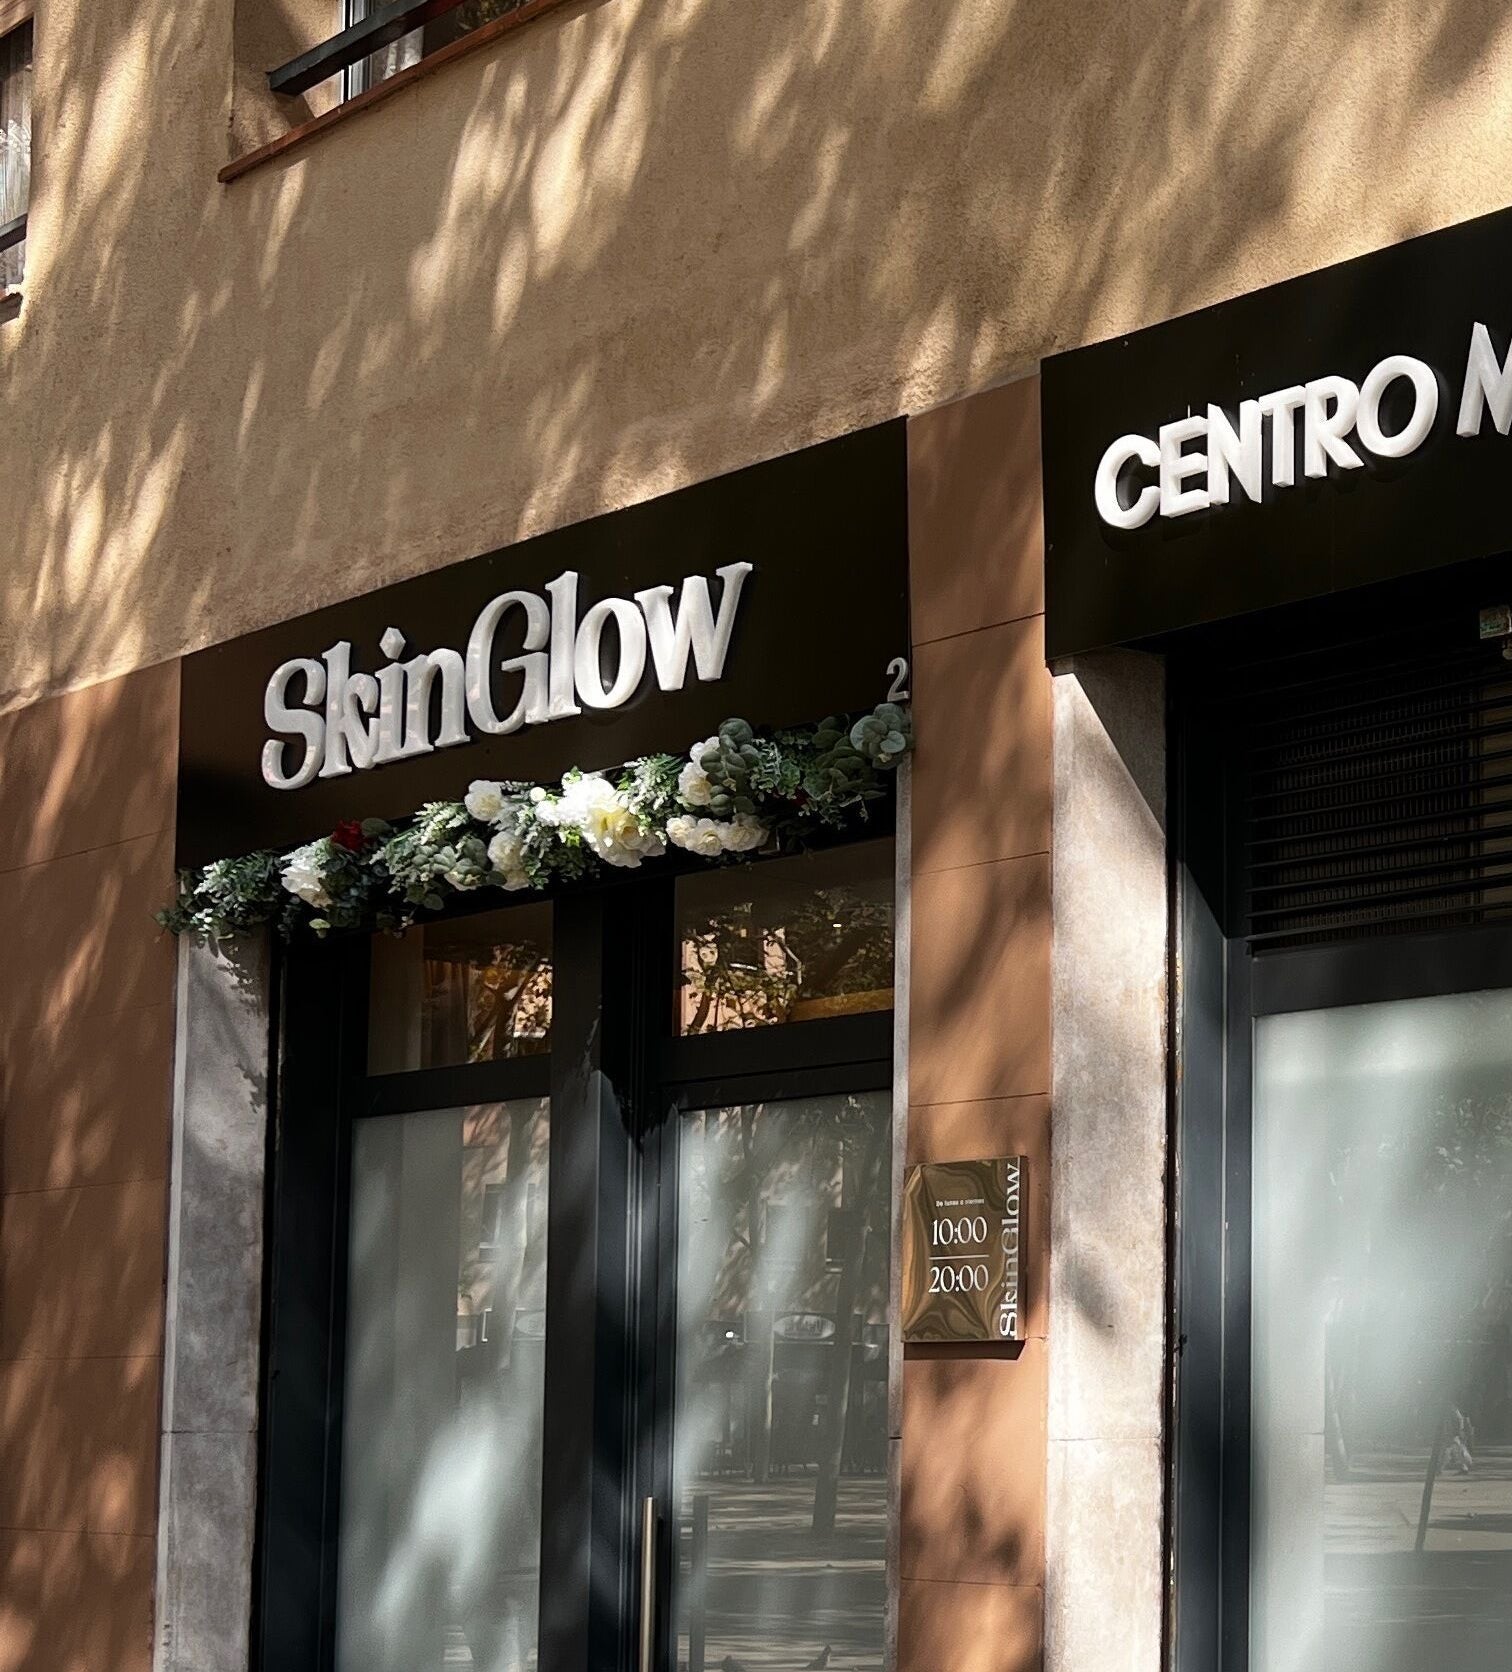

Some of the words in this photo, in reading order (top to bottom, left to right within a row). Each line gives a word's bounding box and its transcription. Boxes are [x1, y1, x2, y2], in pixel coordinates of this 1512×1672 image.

[1094, 354, 1438, 530] CENTRO
[261, 561, 753, 790] SkinGlow
[886, 656, 910, 702] 2
[932, 1216, 988, 1245] 10:00
[928, 1264, 989, 1293] 20:00
